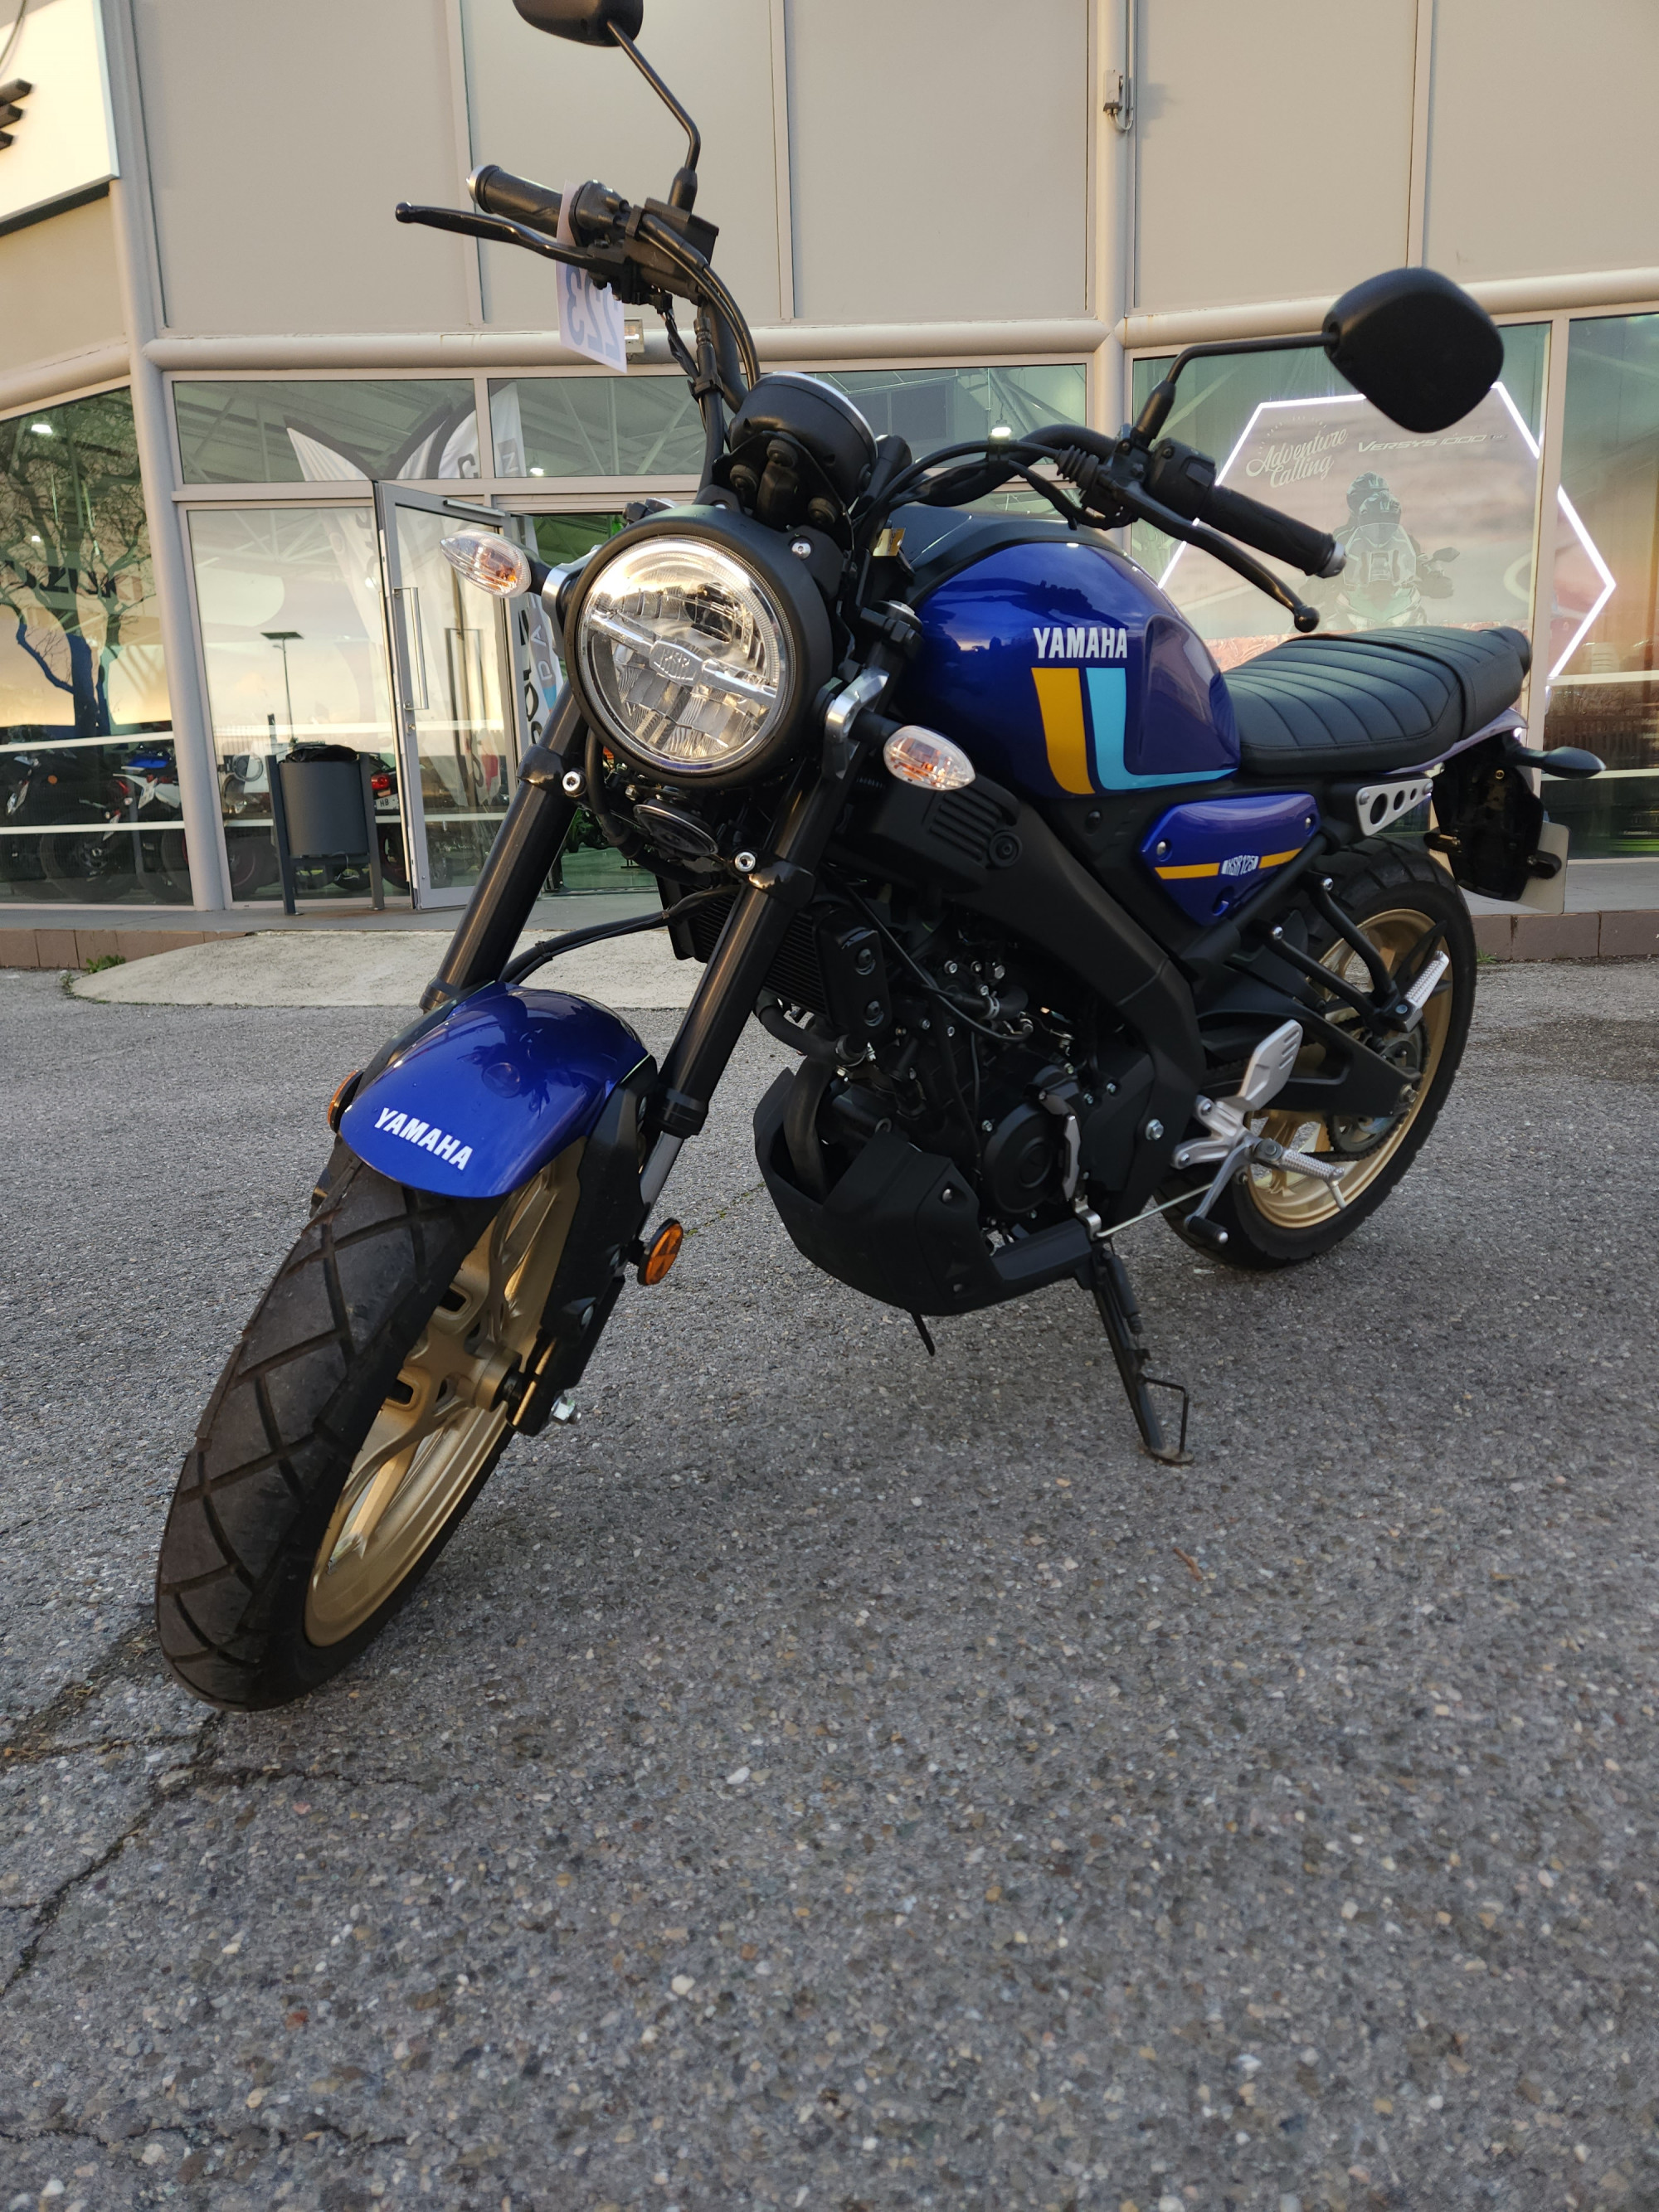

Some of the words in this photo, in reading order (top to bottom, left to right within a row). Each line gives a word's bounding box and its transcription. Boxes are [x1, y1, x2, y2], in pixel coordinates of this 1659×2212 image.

[1246, 428, 1348, 477] Adventure
[1358, 438, 1439, 453] VERSYS
[1440, 435, 1487, 446] 1000
[1270, 455, 1335, 488] Calling
[1033, 627, 1127, 659] YAMAHA
[374, 1107, 474, 1171] YAMAHA
